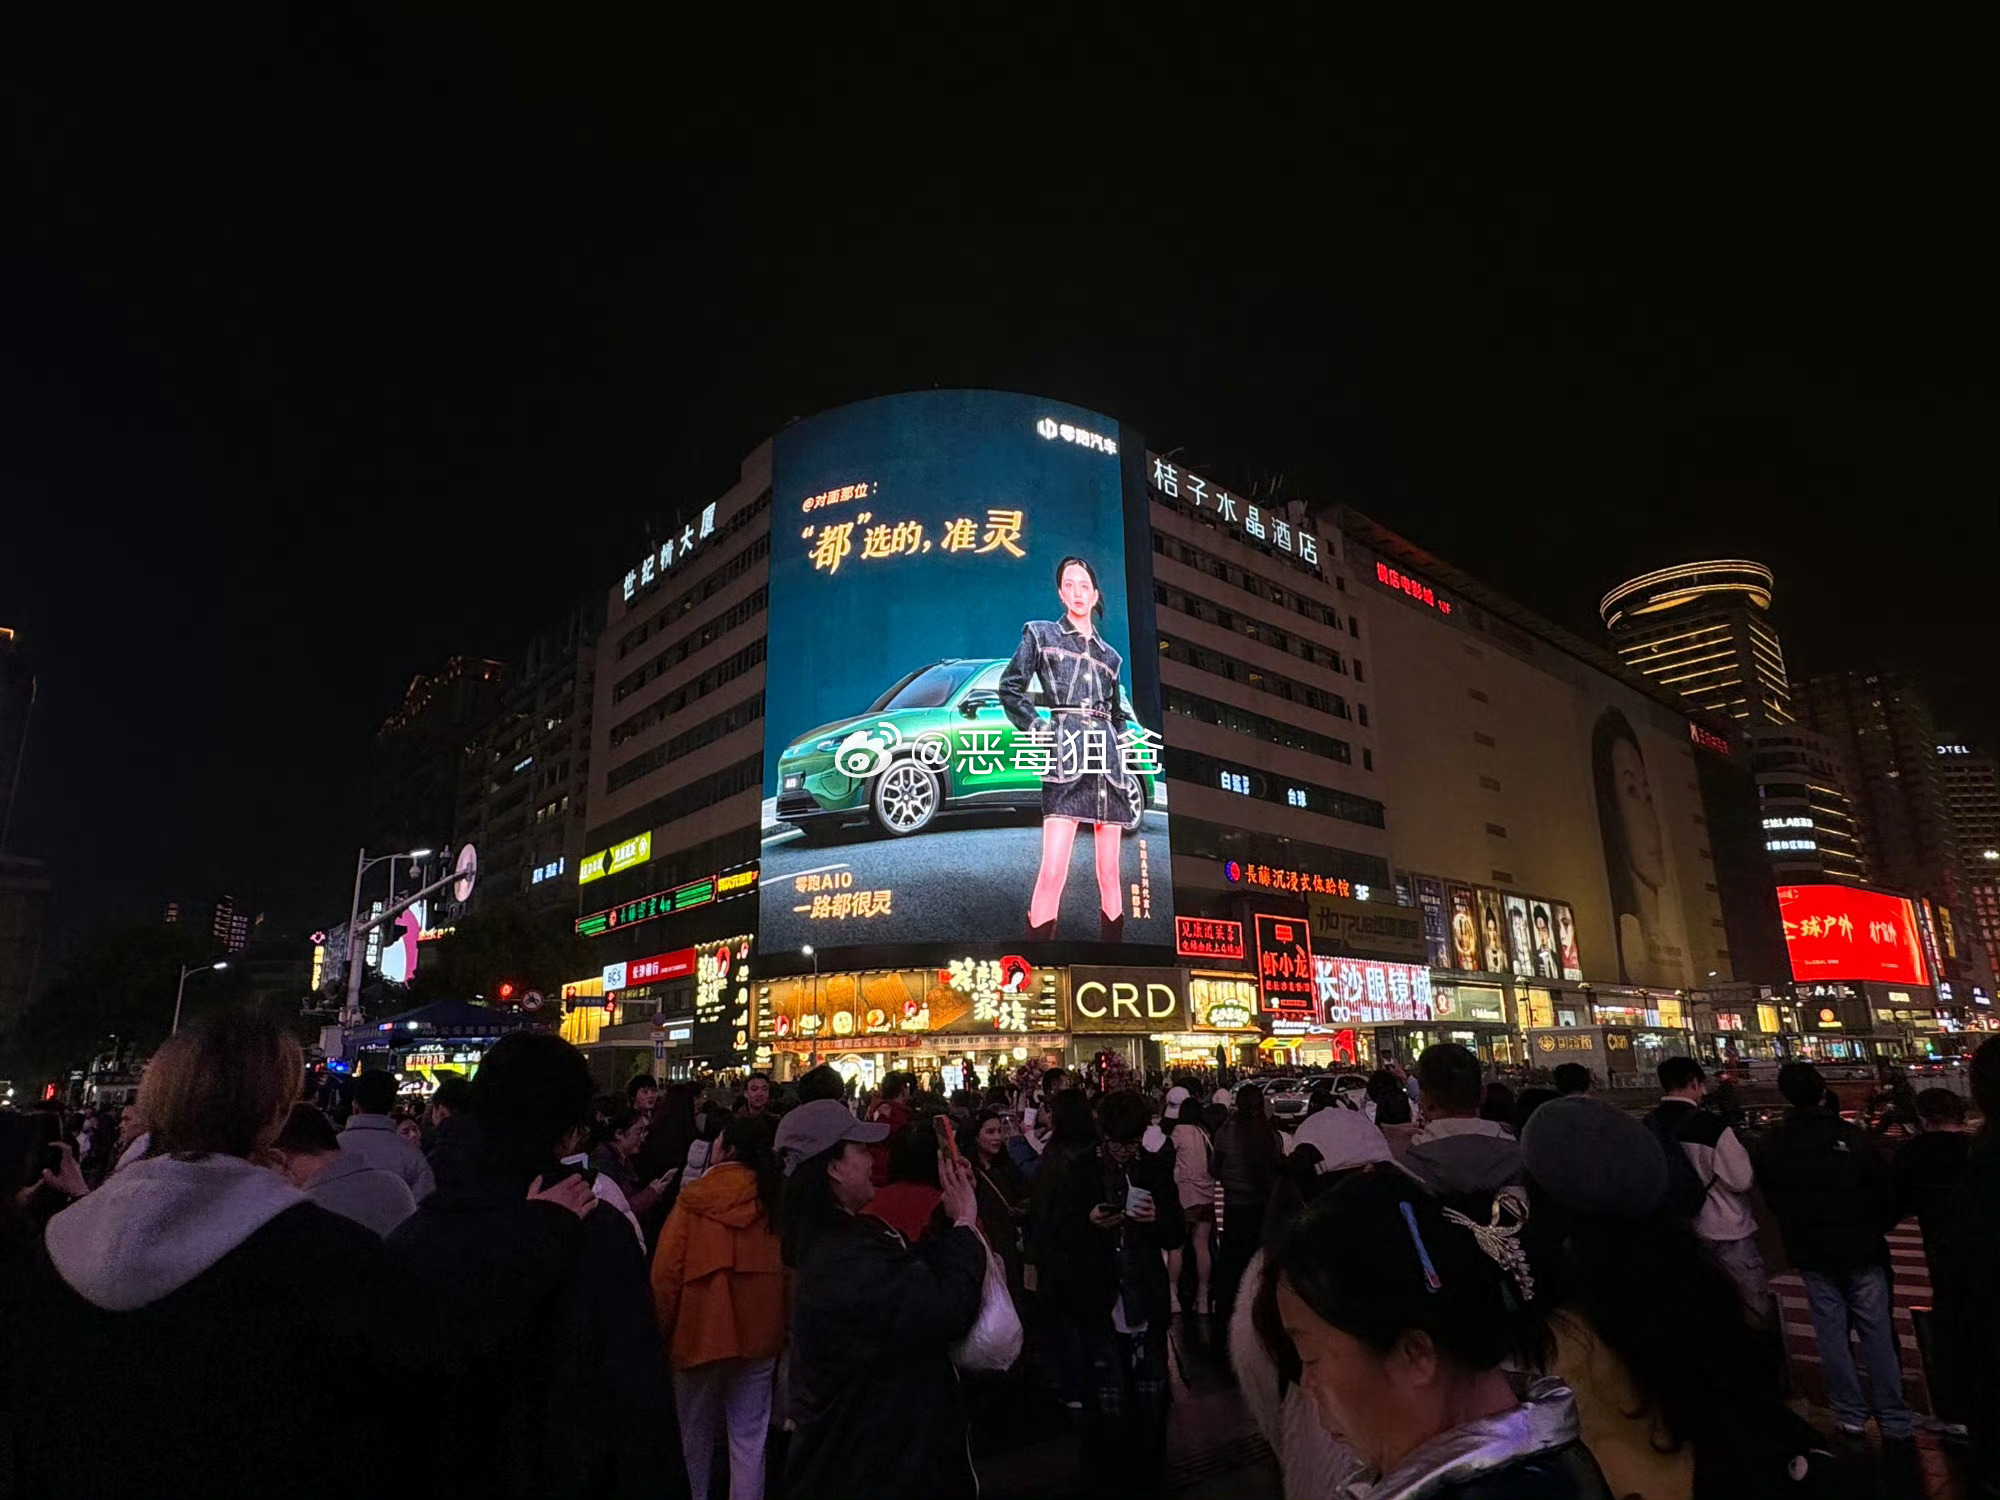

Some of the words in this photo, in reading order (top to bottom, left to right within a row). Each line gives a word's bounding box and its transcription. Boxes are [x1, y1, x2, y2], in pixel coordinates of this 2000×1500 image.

[1154, 458, 1318, 564] 桔子水晶酒店
[793, 890, 892, 920] 一路都很灵
[1262, 944, 1310, 978] 虾小龙
[1075, 981, 1176, 1018] CRD
[1316, 960, 1432, 1006] 长沙眼镜城
